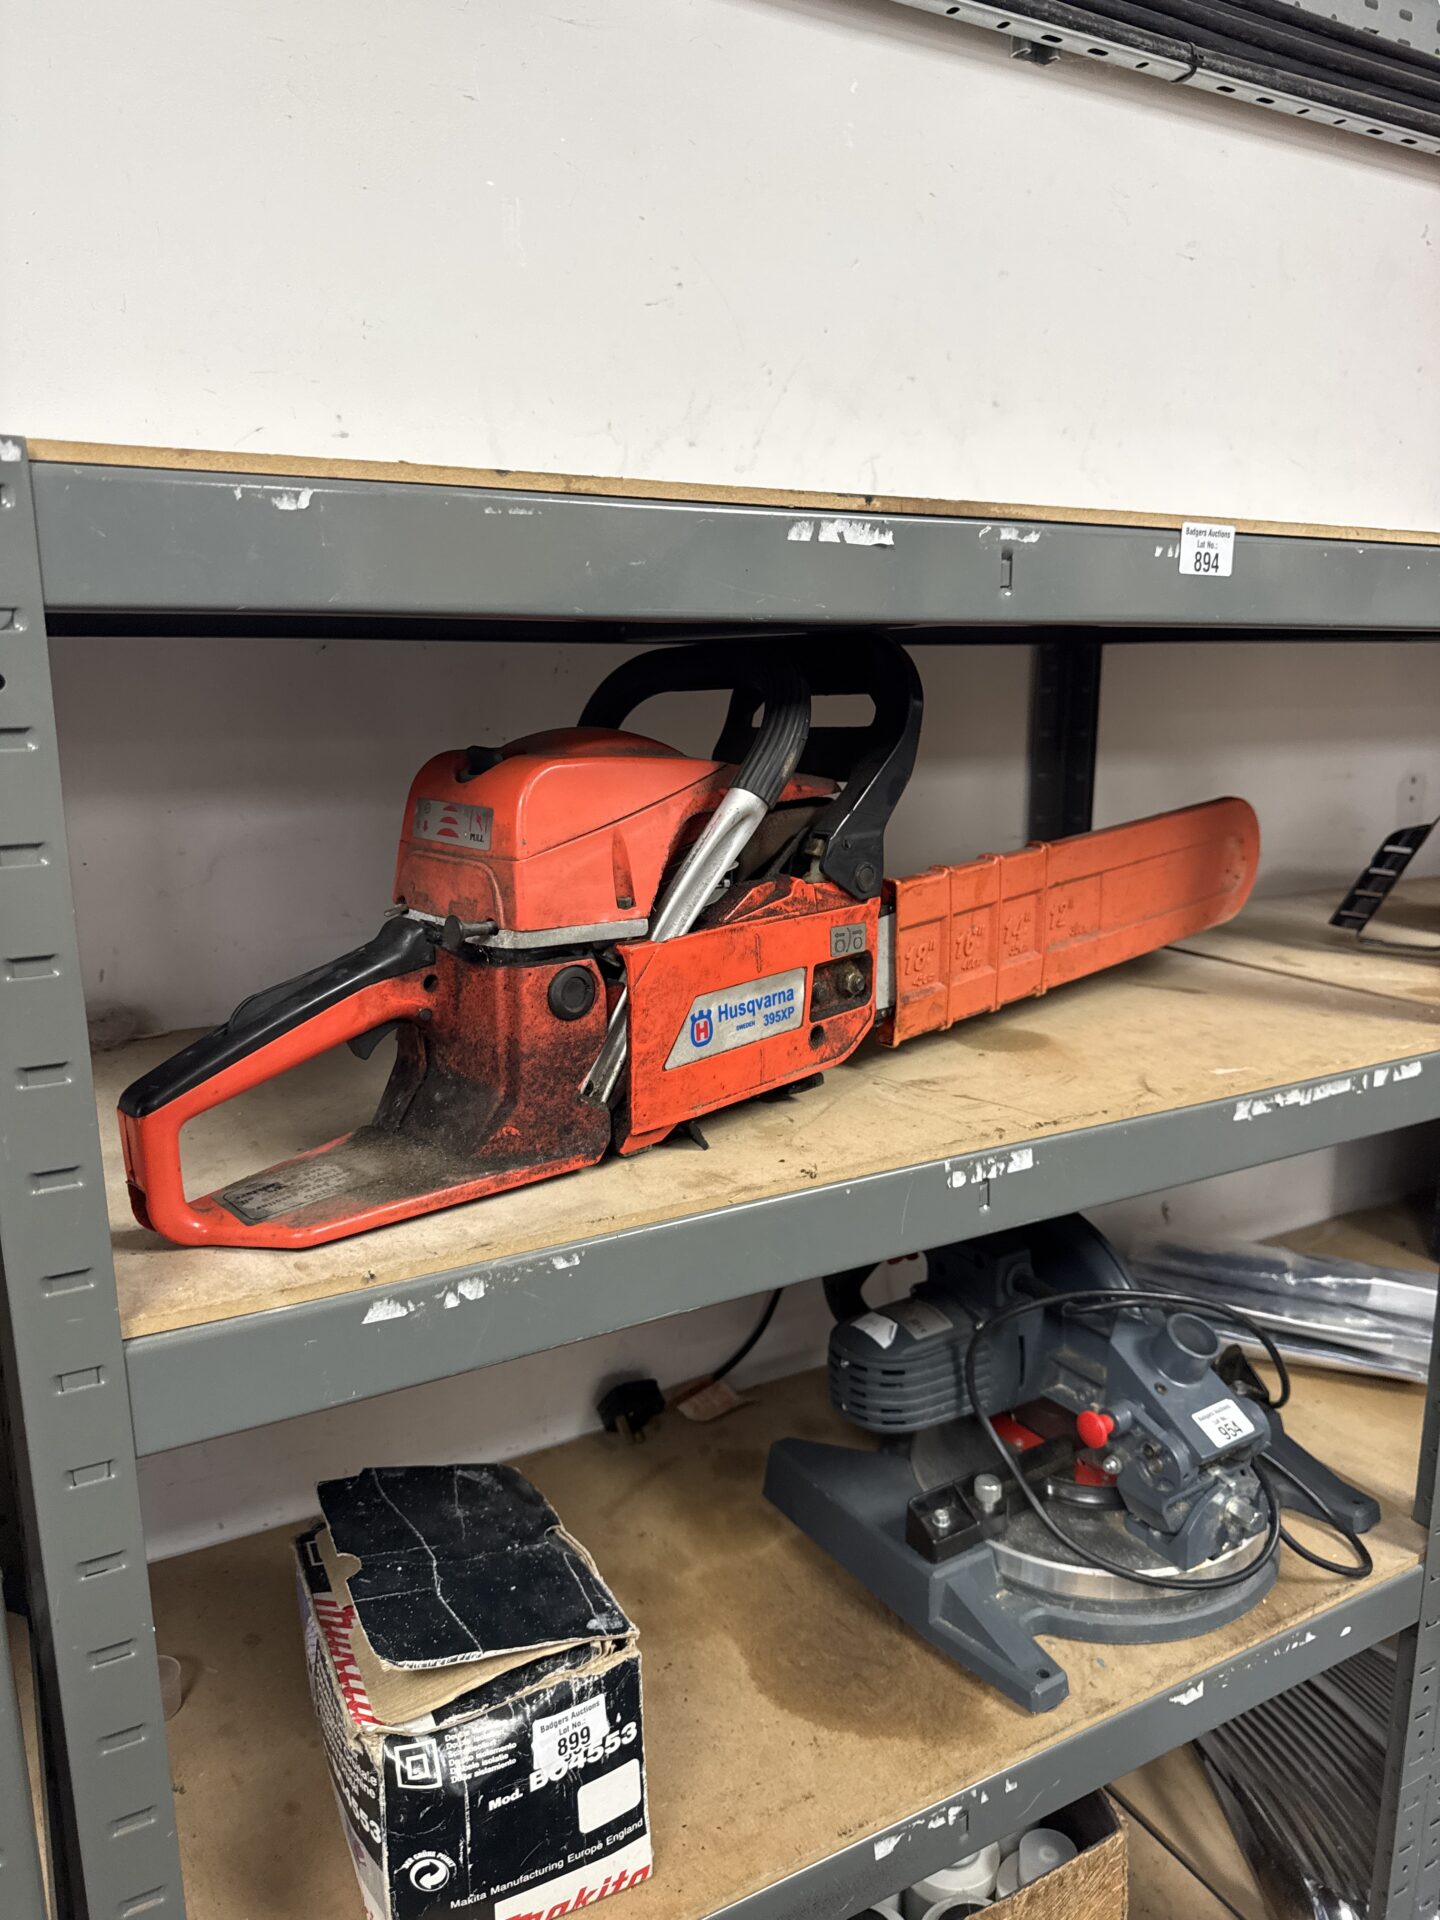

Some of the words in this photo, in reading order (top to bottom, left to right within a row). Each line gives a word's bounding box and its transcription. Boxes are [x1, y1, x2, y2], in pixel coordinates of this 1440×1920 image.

[1185, 526, 1207, 538] Badgers
[1207, 529, 1231, 539] Auctions
[1196, 540, 1206, 548] Lot
[1194, 551, 1219, 573] 894
[718, 988, 795, 1023] Husqvarna
[736, 1020, 756, 1031] SWEDEN
[763, 1006, 795, 1027] 395XP
[1217, 1420, 1243, 1440] 954
[540, 1715, 569, 1734] Badgers
[570, 1701, 600, 1719] Auctions
[557, 1726, 591, 1757] 899
[558, 1726, 570, 1736] Lot
[488, 1787, 524, 1812] Mod.
[450, 1891, 488, 1909] Makita
[490, 1859, 564, 1896] Manufacturing
[567, 1840, 603, 1864] Europe
[606, 1818, 644, 1846] England
